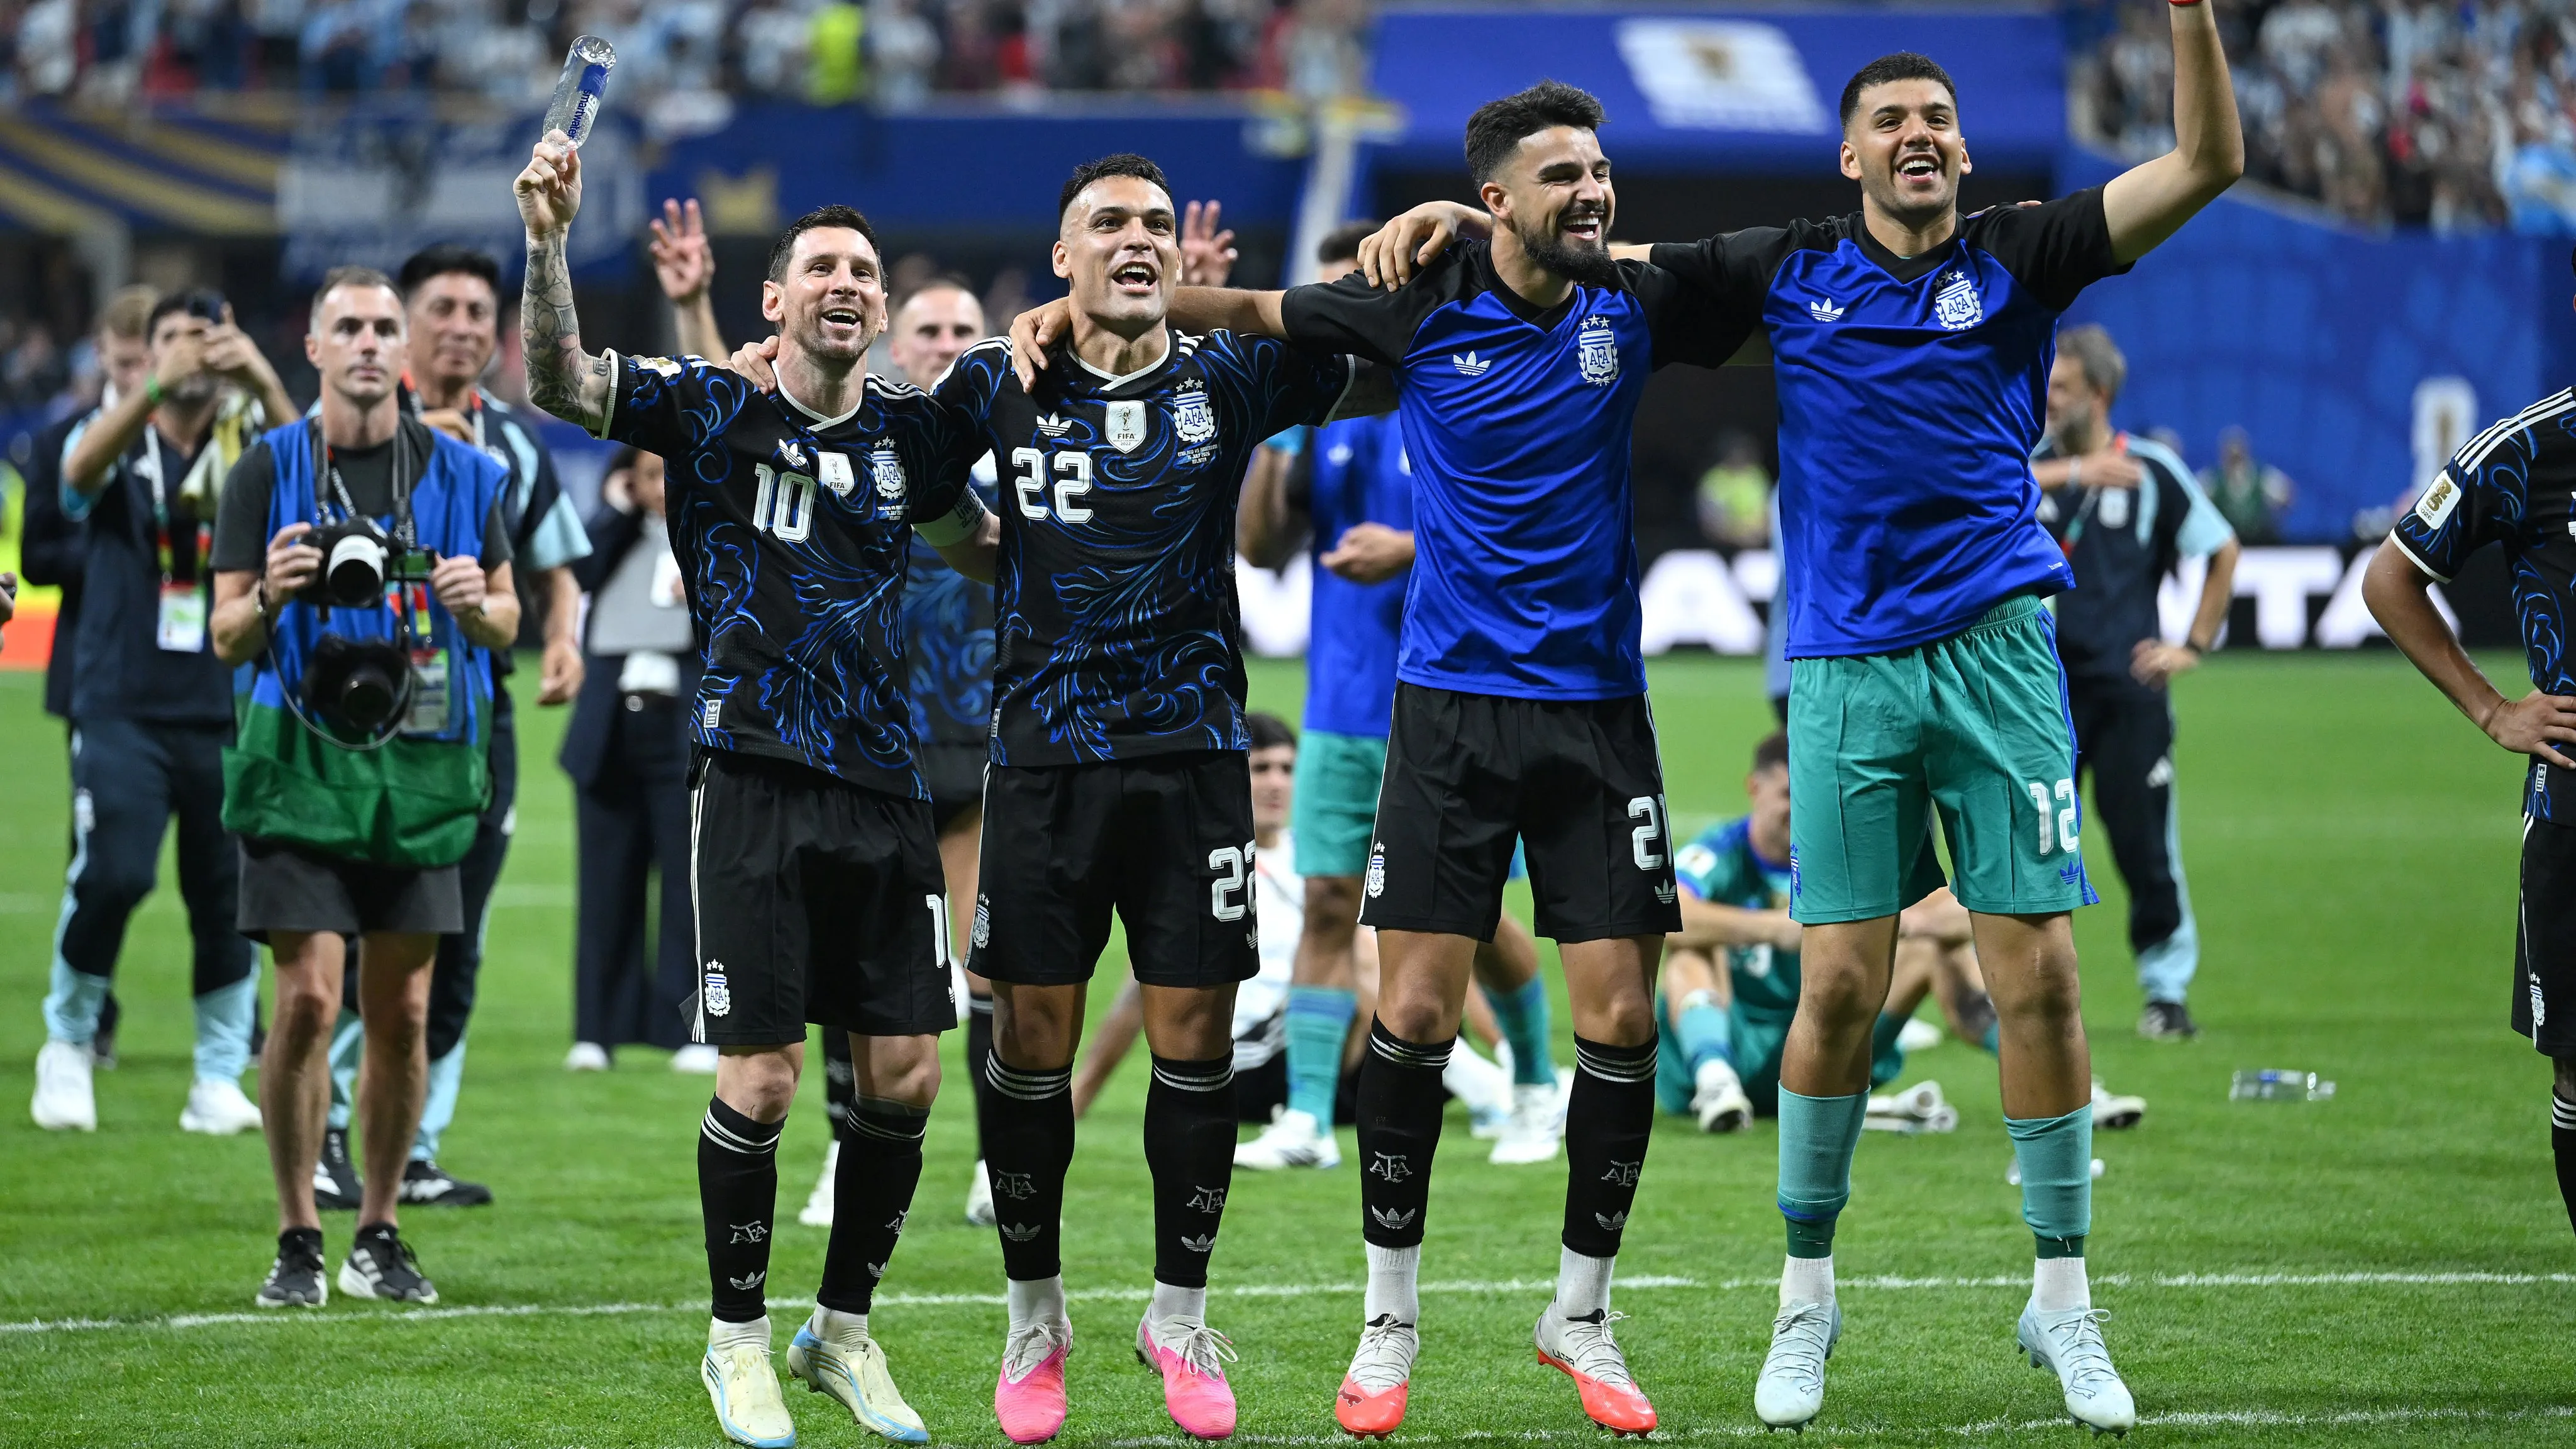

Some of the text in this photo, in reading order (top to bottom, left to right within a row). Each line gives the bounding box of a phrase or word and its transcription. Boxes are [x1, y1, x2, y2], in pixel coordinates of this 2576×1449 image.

[567, 89, 592, 139] smartwater
[1947, 292, 1970, 316] AFA
[1589, 345, 1610, 369] AFA
[1184, 405, 1206, 428] AFA
[882, 463, 900, 484] AFA
[1012, 447, 1094, 523] 22
[753, 462, 817, 543] 10
[2028, 778, 2079, 855] 12
[926, 894, 952, 969] 1
[710, 984, 724, 1004] AFA
[1370, 1151, 1413, 1183] AFA
[996, 1169, 1037, 1201] AFA
[1186, 1185, 1225, 1214] AFA
[730, 1219, 768, 1245] AFA
[1552, 1348, 1575, 1368] ULTRA
